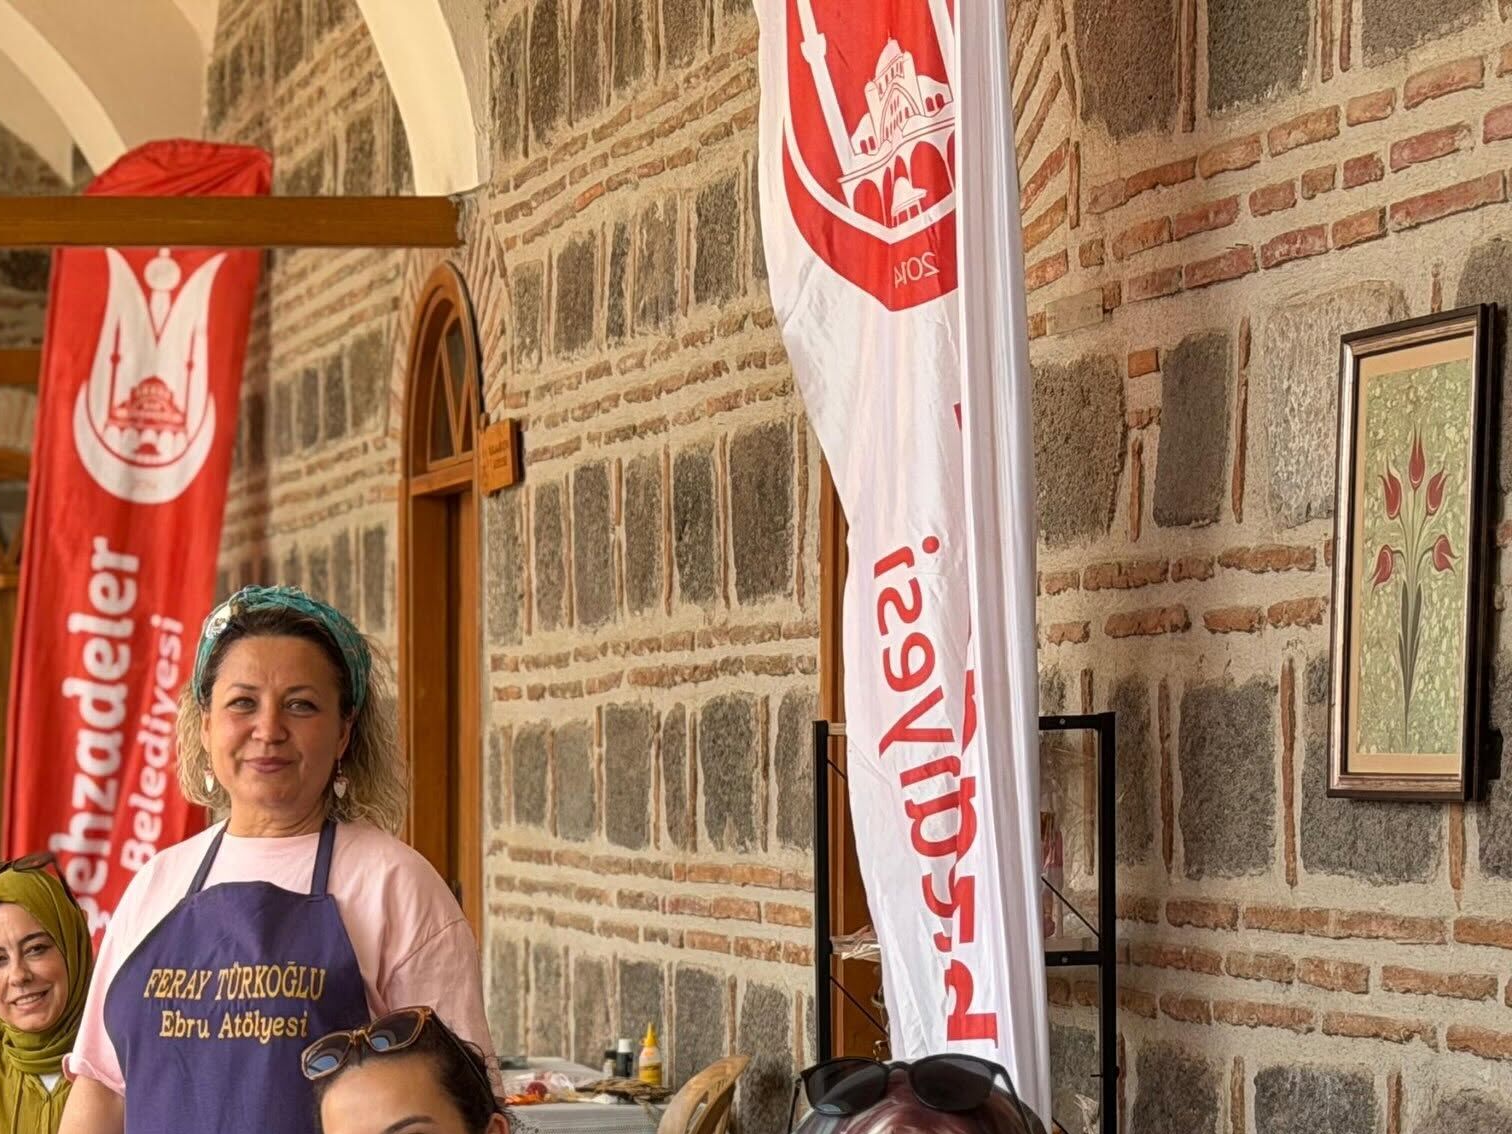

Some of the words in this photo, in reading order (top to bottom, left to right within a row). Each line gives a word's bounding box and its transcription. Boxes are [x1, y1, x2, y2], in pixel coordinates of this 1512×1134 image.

[120, 613, 184, 872] Belediyesi
[143, 968, 213, 1001] FERAY
[215, 961, 327, 1001] TÜRKOĞLU
[159, 1009, 210, 1039] Ebru
[217, 1009, 308, 1045] Atölyesi
